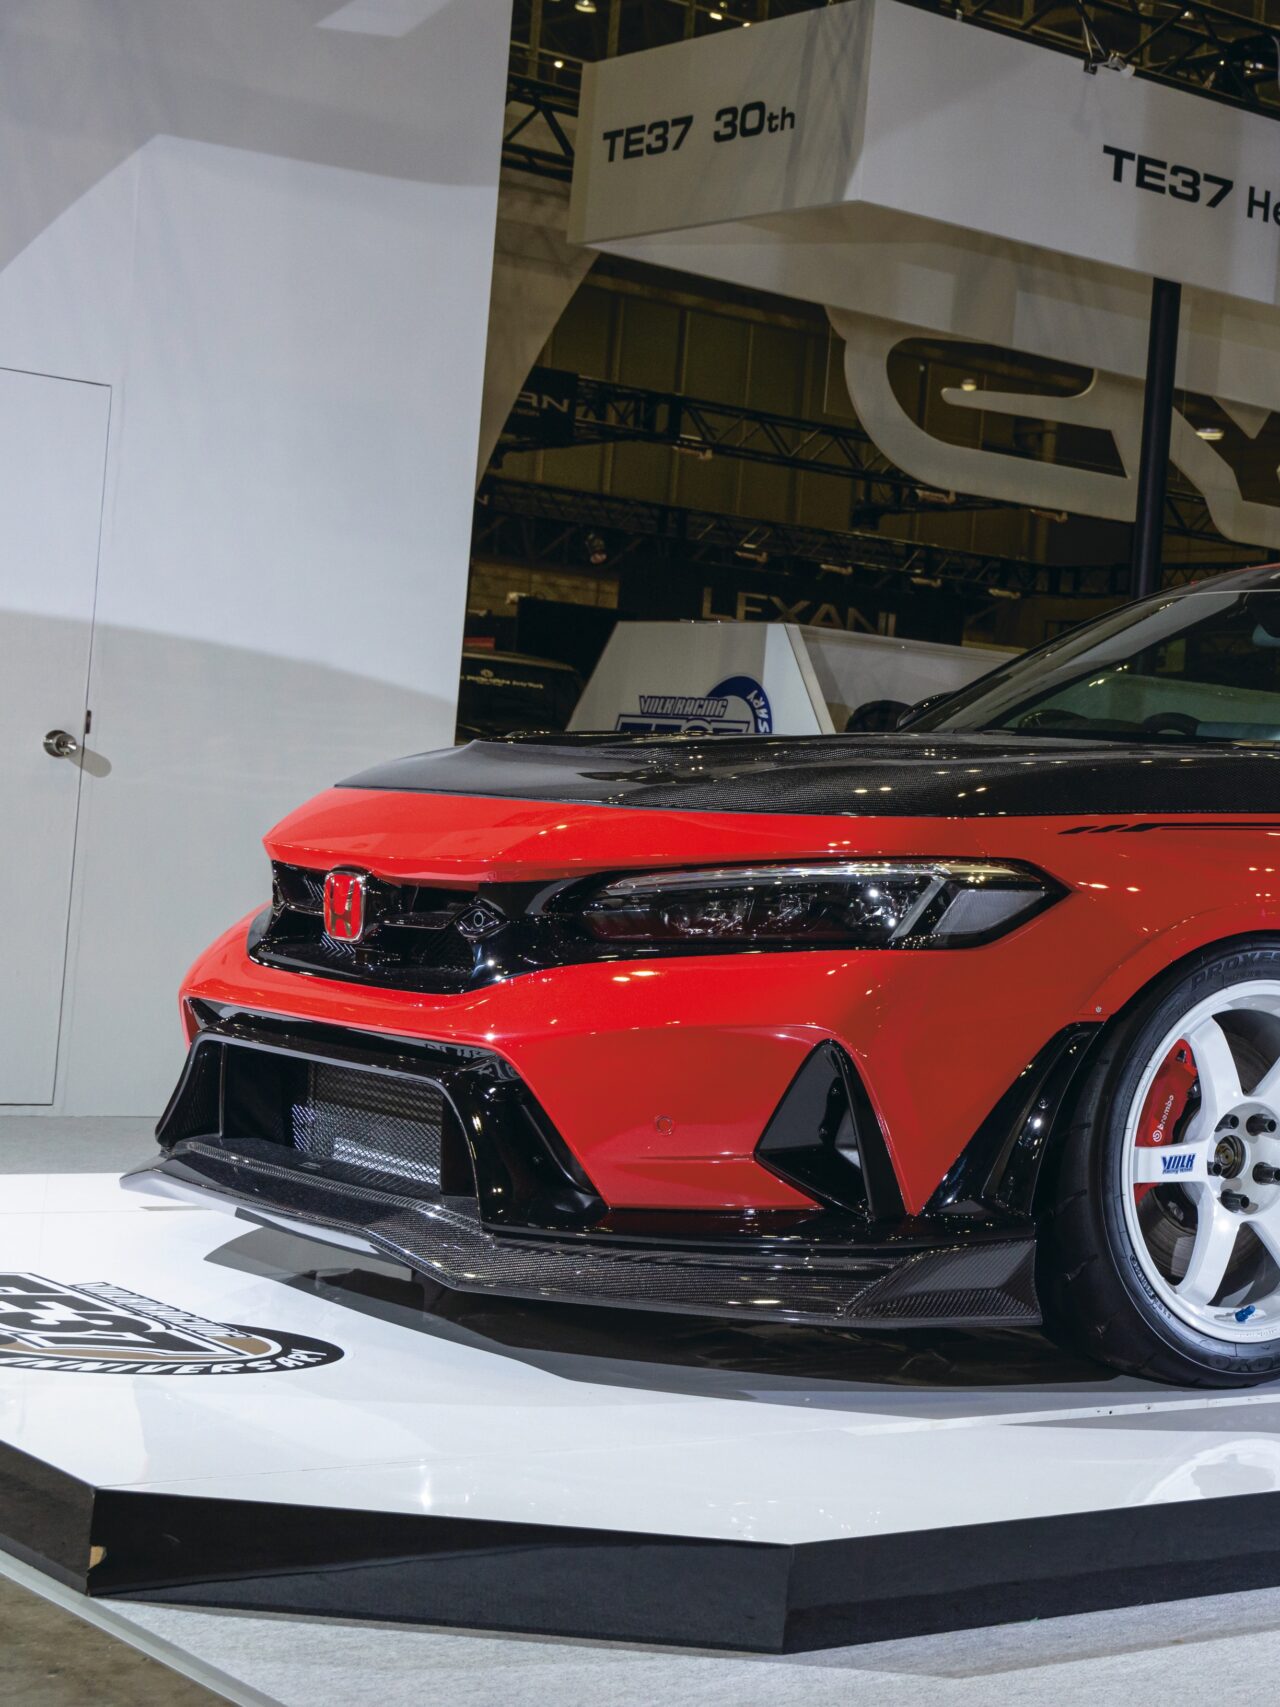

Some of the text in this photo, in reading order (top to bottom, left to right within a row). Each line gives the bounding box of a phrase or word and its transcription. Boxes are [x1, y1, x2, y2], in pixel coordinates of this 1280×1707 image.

[603, 101, 795, 163] TE37 30th
[1103, 144, 1234, 209] TE37
[701, 586, 897, 637] LEXANI
[639, 695, 675, 714] VOLK
[674, 696, 728, 718] RACING
[1157, 1094, 1174, 1130] brembo
